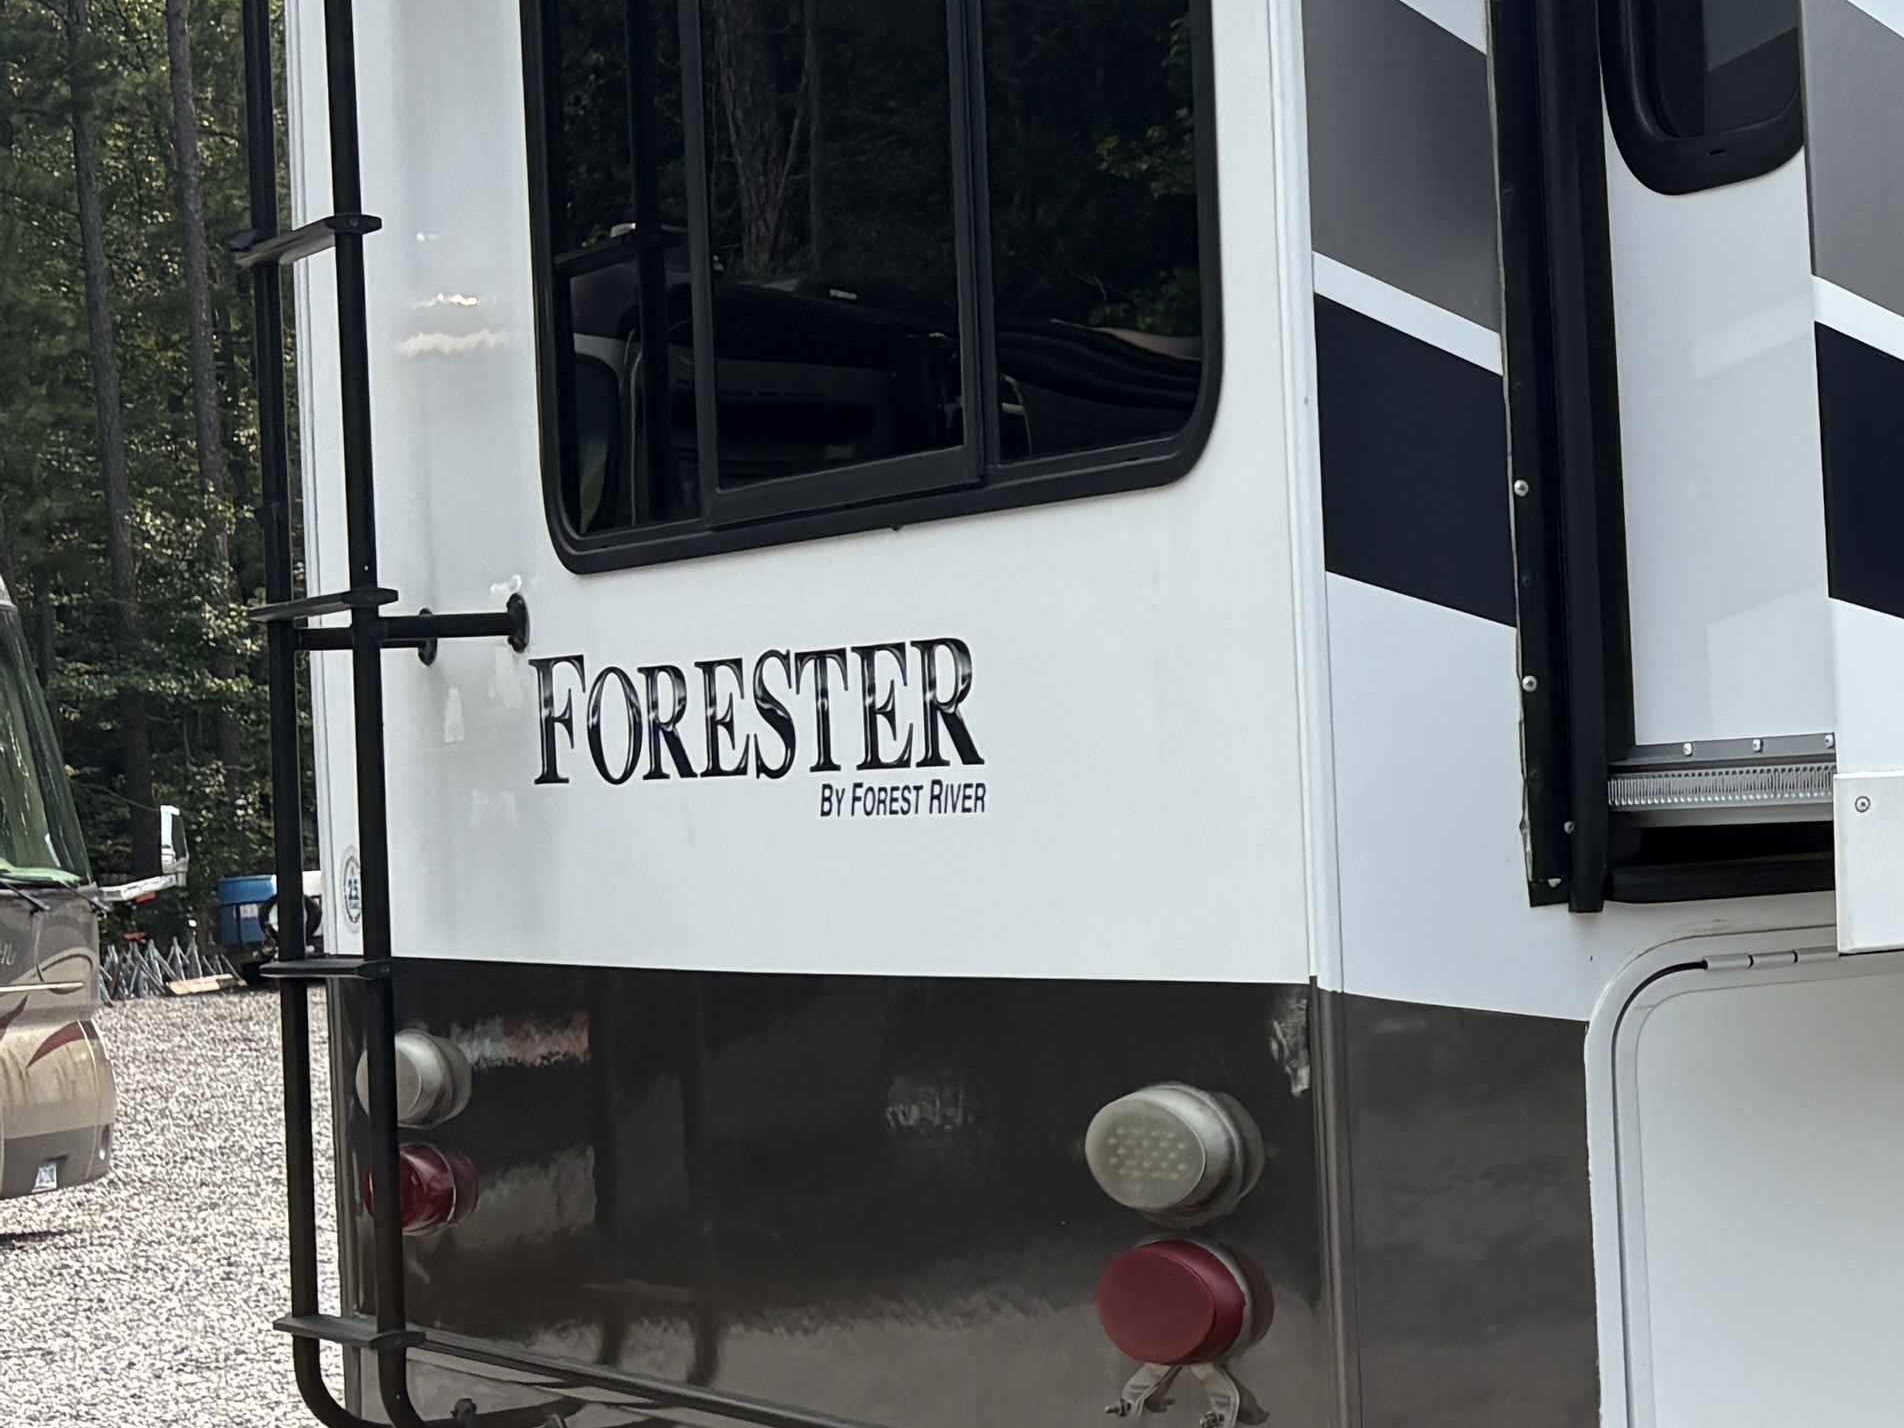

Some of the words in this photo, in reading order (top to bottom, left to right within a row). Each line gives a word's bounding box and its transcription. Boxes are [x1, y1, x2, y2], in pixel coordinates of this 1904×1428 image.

[528, 636, 986, 786] FORESTER
[851, 781, 924, 817] FOREST
[929, 778, 987, 815] RIVER
